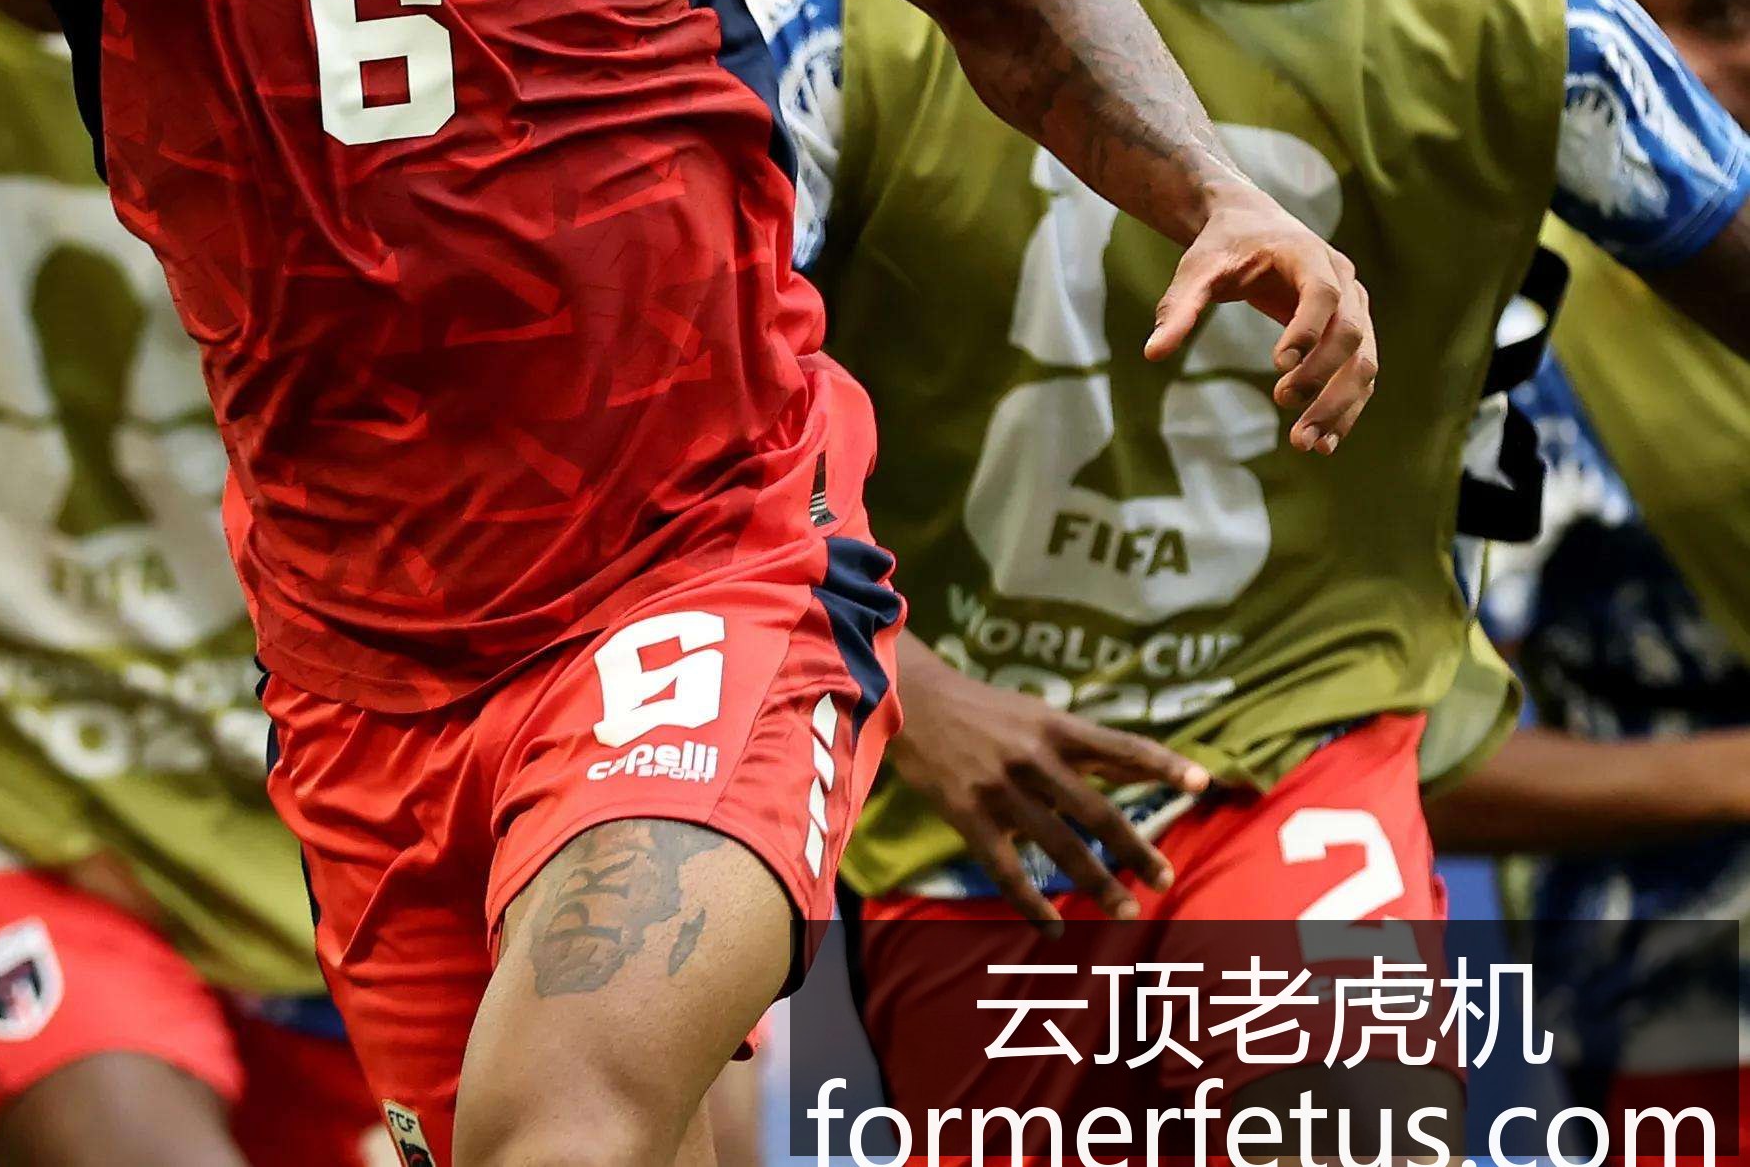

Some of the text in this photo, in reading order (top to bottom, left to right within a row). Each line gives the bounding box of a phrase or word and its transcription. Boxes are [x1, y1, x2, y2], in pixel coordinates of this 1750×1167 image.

[1046, 512, 1190, 576] FIFA
[947, 584, 1134, 671] WORLD
[593, 611, 725, 747] 6
[637, 764, 716, 783] SPORT
[1277, 807, 1423, 964] 2
[388, 1109, 416, 1133] FCF
